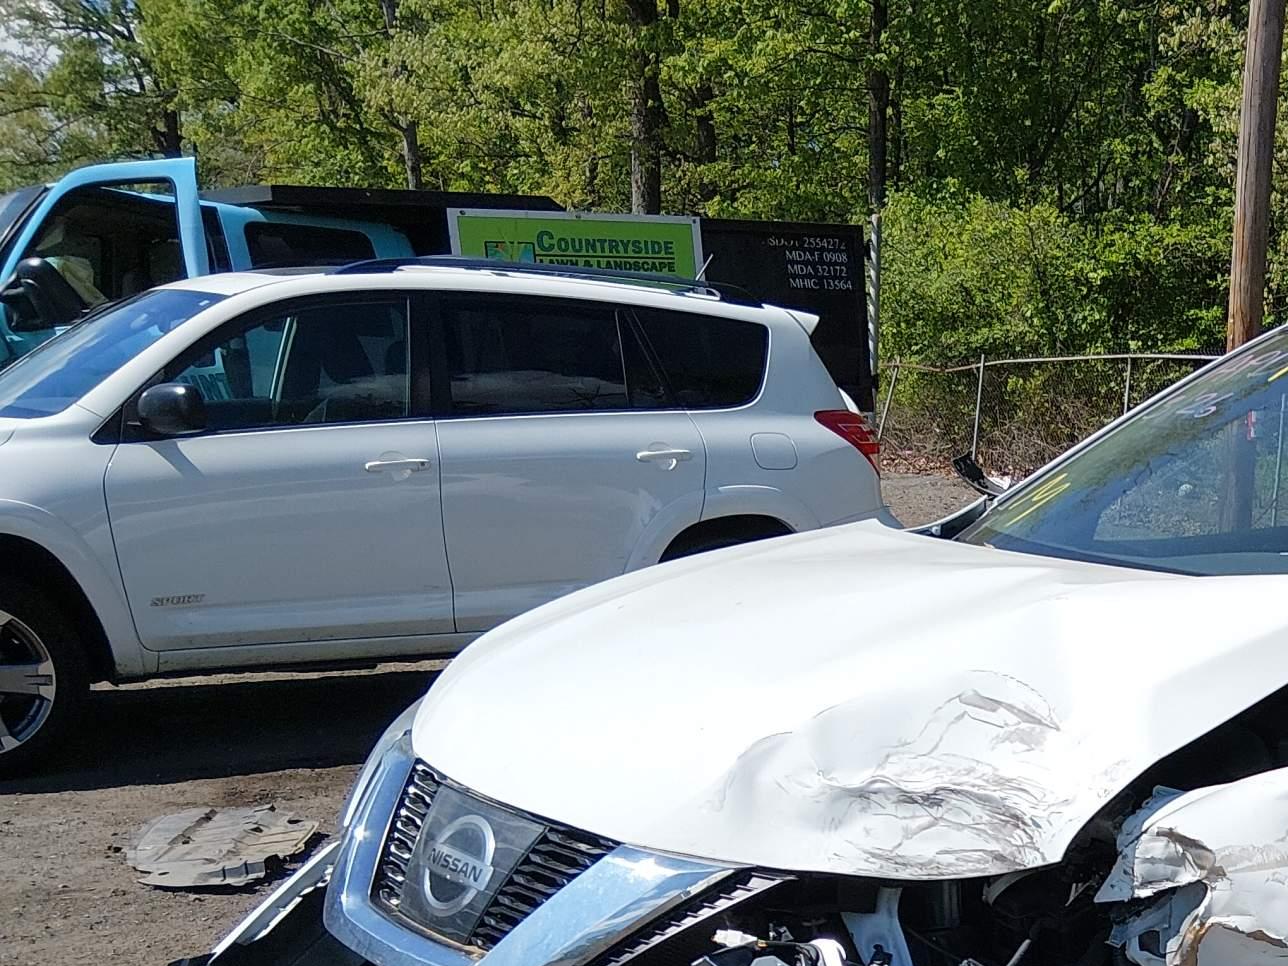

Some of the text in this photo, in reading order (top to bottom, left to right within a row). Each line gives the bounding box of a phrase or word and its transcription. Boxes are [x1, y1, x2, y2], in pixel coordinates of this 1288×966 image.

[536, 230, 675, 255] COUNTRYSIDE
[823, 251, 848, 263] 0908
[596, 259, 676, 273] LANDSCAPE
[787, 263, 848, 277] MDA 32172
[789, 277, 853, 291] MHIC 13564
[428, 847, 483, 883] NISSAN
